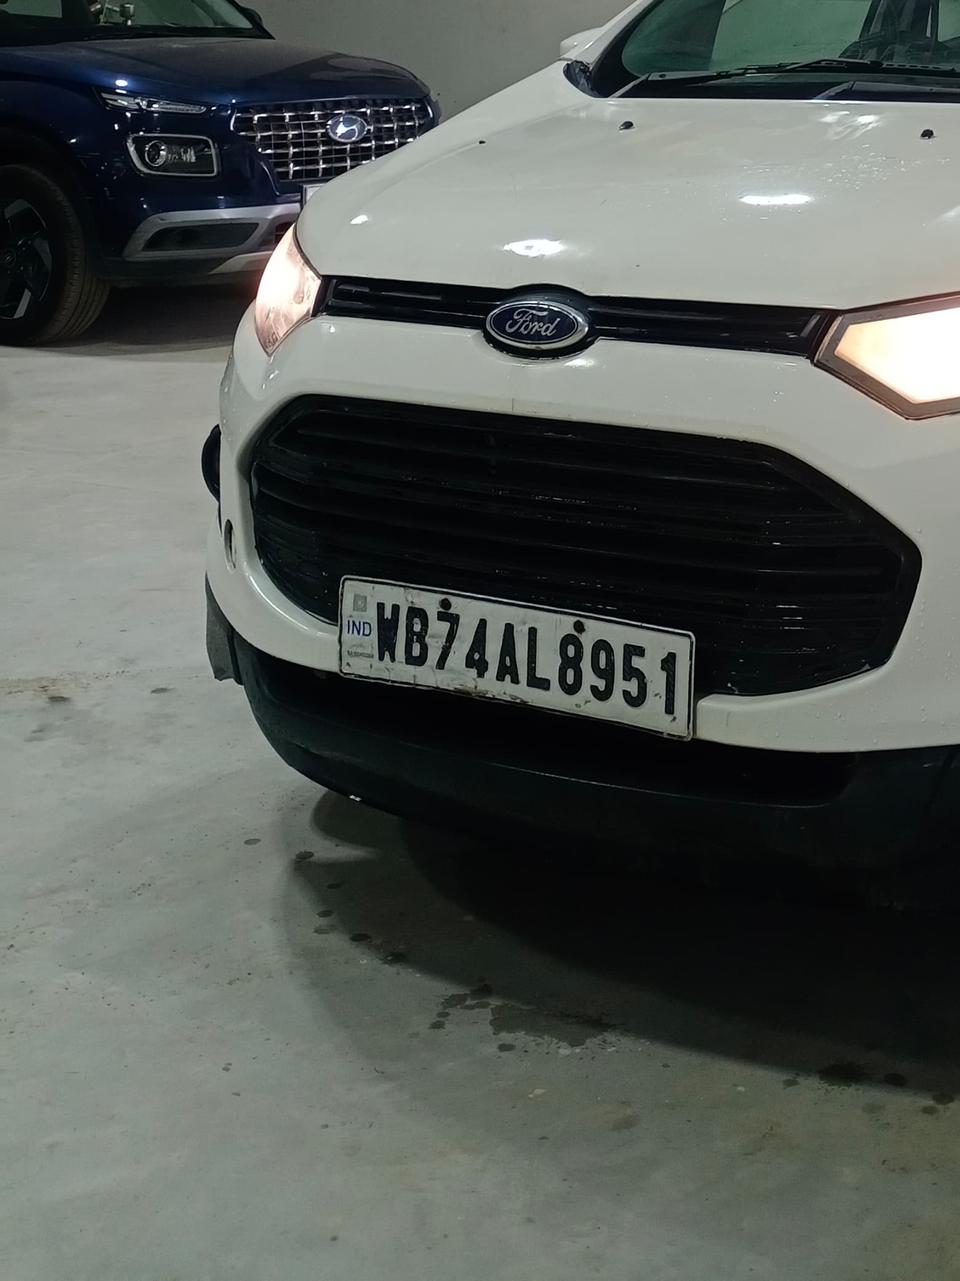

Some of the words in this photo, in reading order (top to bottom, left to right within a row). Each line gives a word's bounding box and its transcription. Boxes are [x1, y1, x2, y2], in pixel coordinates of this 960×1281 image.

[505, 308, 561, 336] Ford
[347, 619, 372, 637] IND
[376, 601, 677, 716] WB74AL8951
